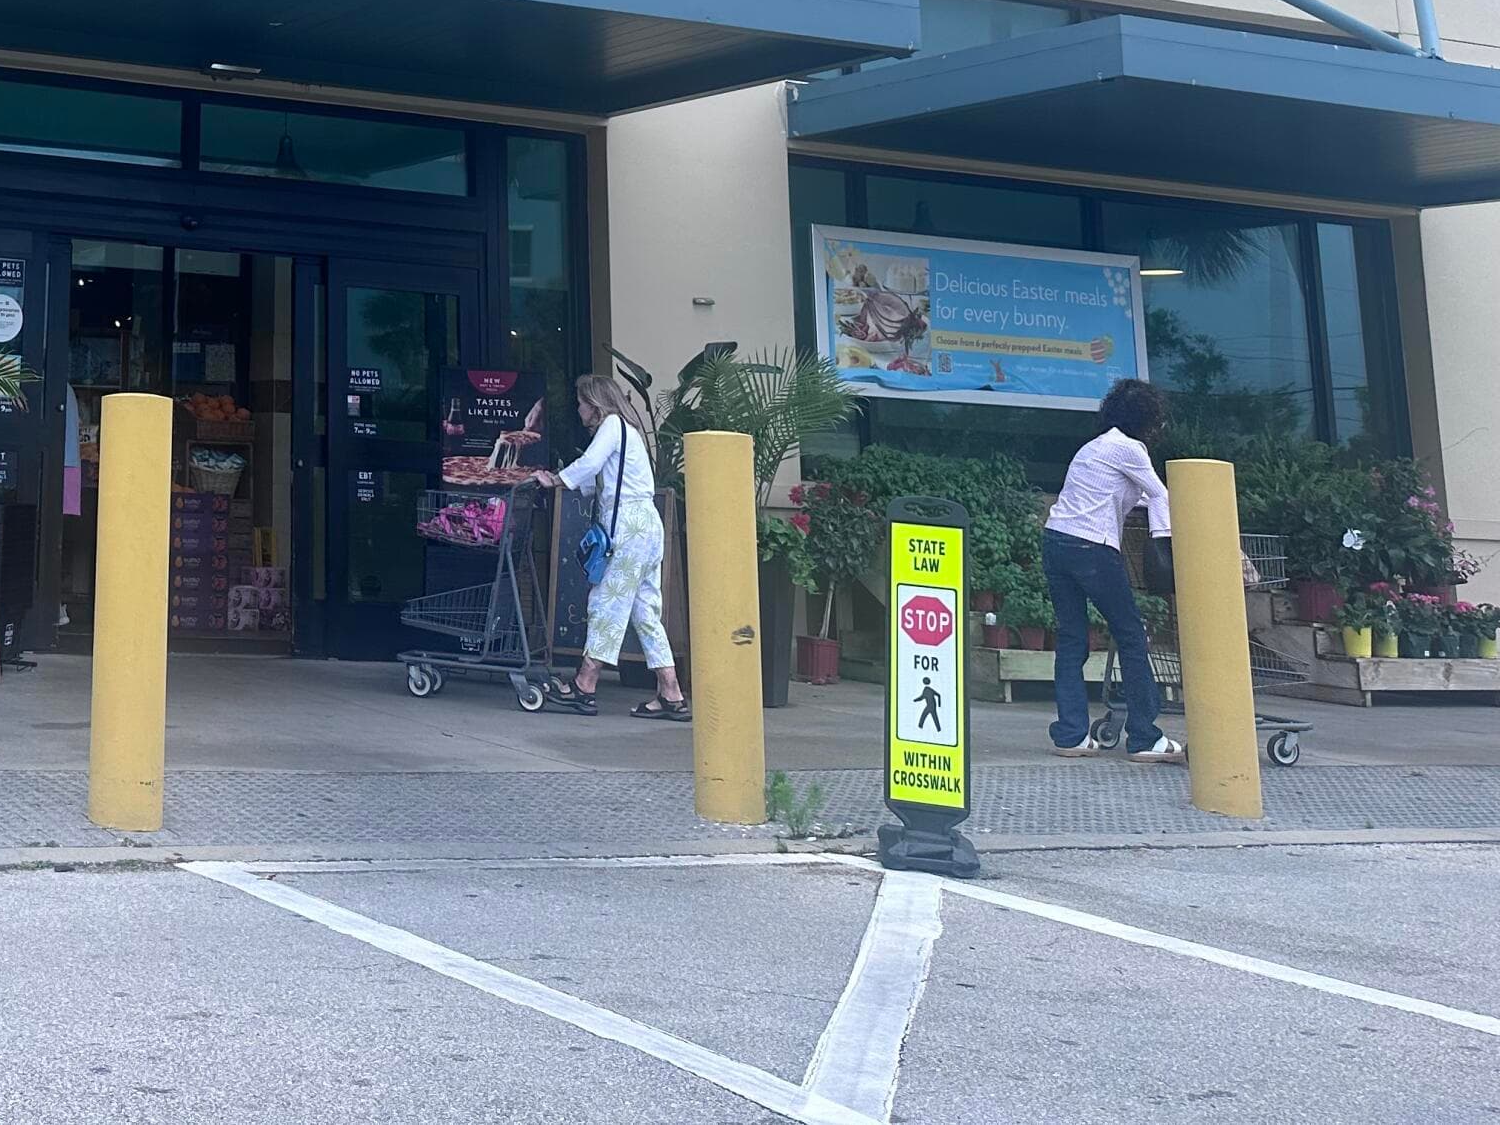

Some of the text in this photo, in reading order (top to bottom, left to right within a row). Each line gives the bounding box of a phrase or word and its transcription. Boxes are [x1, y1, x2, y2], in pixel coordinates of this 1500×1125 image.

[2, 261, 21, 270] PETS
[935, 272, 1108, 308] Delicious Easter meals
[935, 298, 1069, 335] for every bunny.
[936, 335, 1083, 355] Choose from 6 perfectly prepped Easter meals
[349, 377, 380, 386] ALLOWED
[362, 370, 379, 378] PETS
[476, 398, 512, 406] TASTES
[468, 408, 519, 418] LIKE ITALY
[359, 471, 373, 480] EBT
[908, 538, 946, 556] STATE
[913, 556, 940, 573] LAW
[904, 608, 950, 633] STOP
[913, 654, 939, 672] FOR
[903, 750, 951, 772] WITHIN
[893, 769, 962, 794] CROSSWALK
